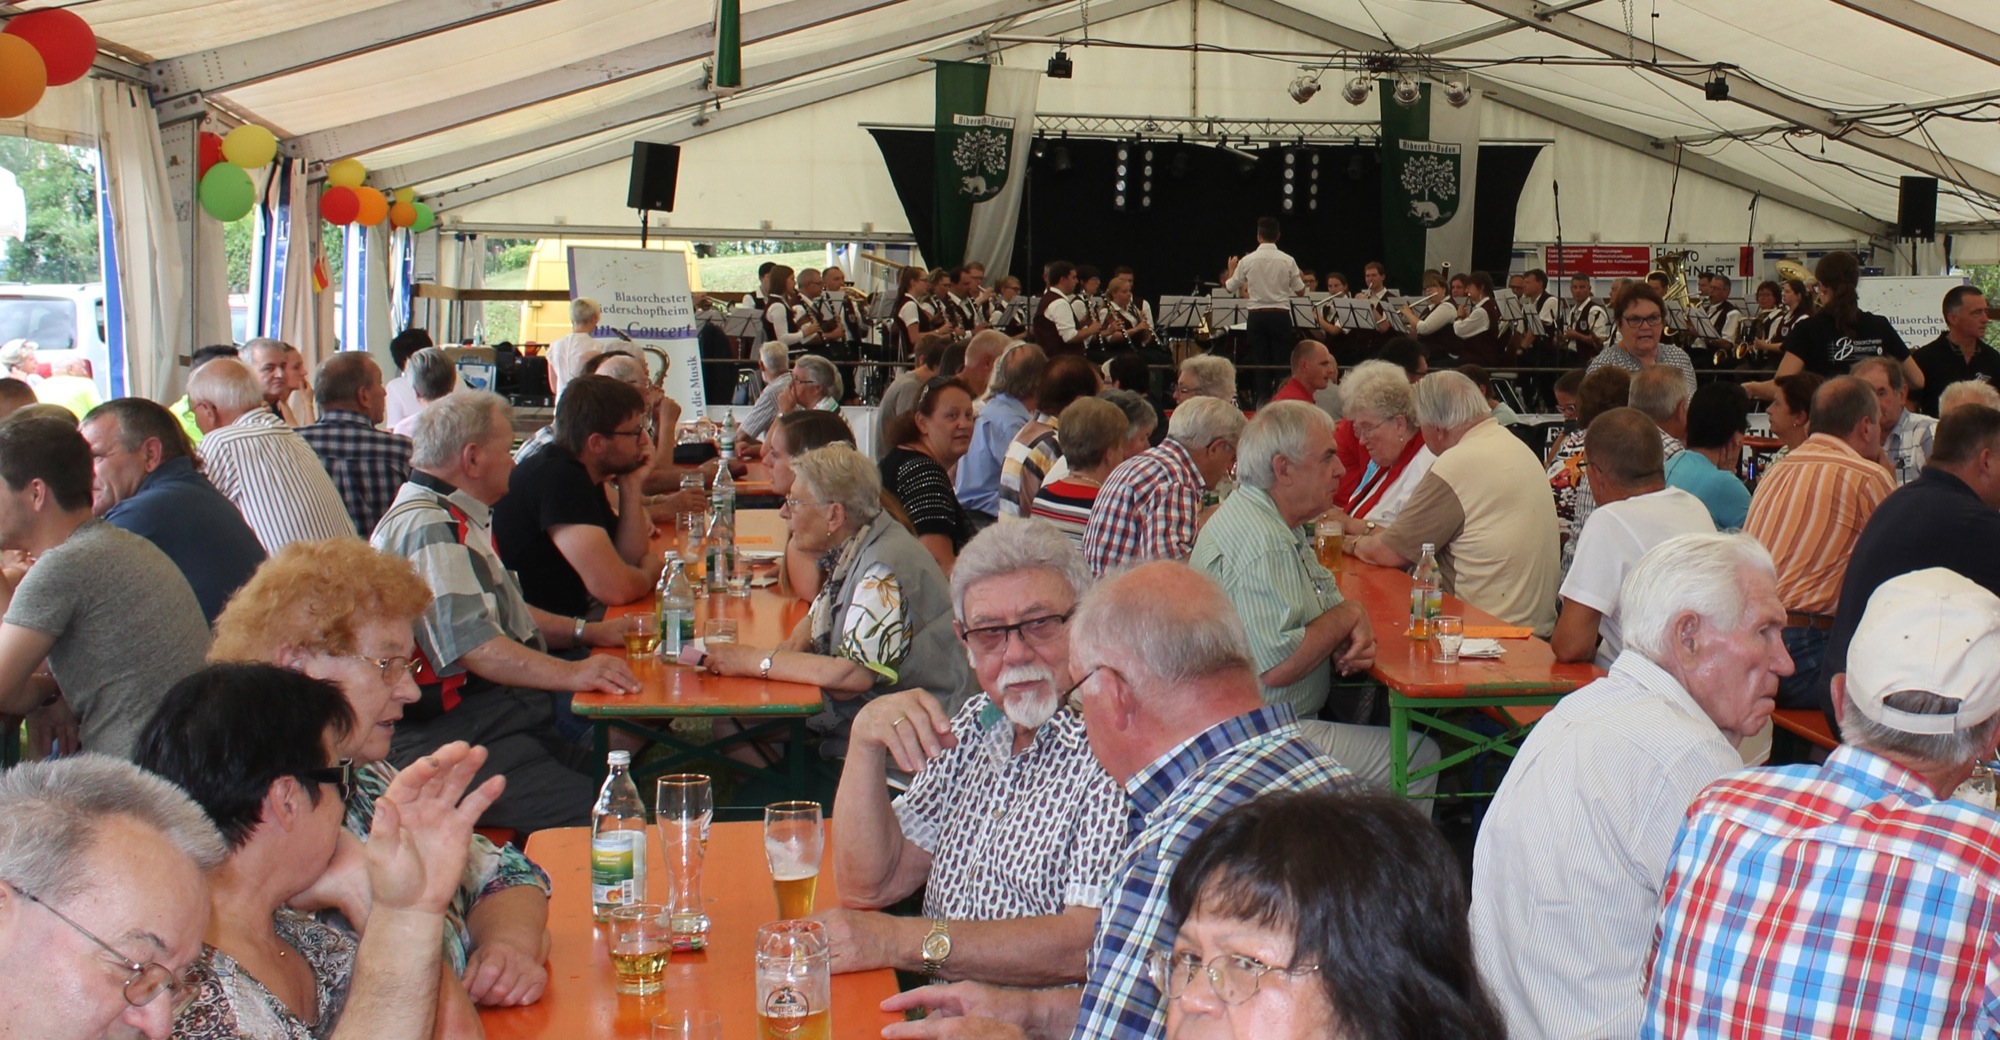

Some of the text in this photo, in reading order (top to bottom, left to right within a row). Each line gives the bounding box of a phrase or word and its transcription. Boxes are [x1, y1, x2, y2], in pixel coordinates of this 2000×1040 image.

[1656, 265, 1734, 276] HNERT
[615, 292, 687, 303] Blasorchester
[600, 305, 689, 318] iederschopfheim
[1889, 315, 1944, 325] Blasorches
[627, 321, 692, 337] Concert
[687, 355, 701, 388] Musik
[691, 391, 703, 407] die
